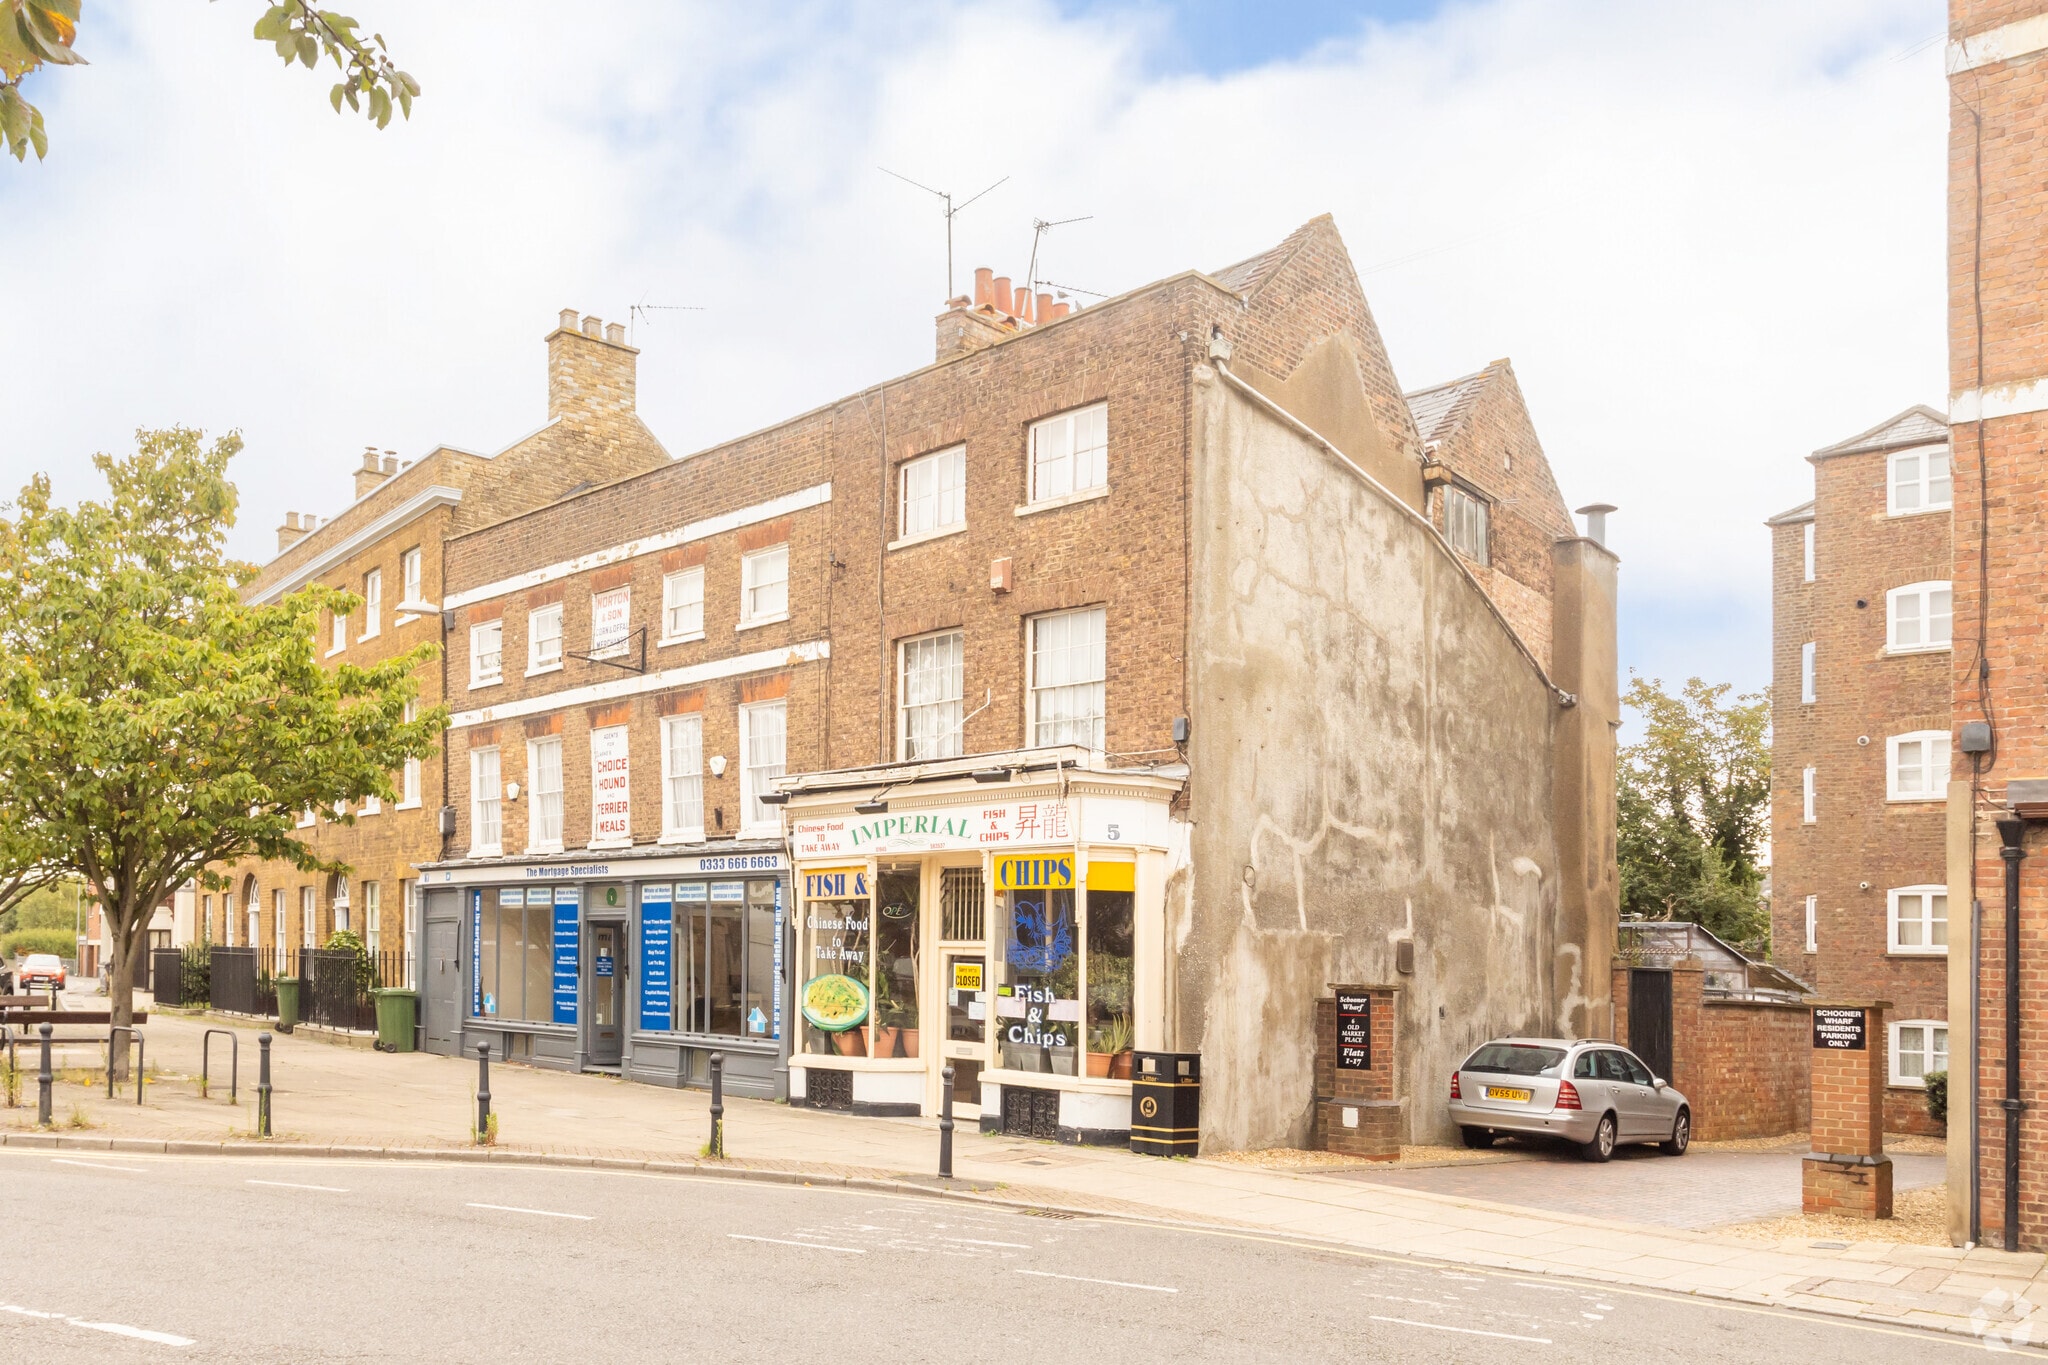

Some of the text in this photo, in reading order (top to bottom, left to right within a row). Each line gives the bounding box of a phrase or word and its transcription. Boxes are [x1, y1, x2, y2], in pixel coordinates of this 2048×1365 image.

[597, 591, 629, 608] NORTON
[608, 608, 622, 620] SON
[598, 758, 627, 773] CHOICE
[599, 776, 625, 790] HOUND
[598, 801, 628, 815] TERRIER
[983, 809, 1006, 820] FISH
[600, 820, 625, 833] MEALS
[798, 822, 843, 833] Chinese Food
[990, 821, 997, 830] &
[1015, 804, 1068, 840] 昇龍
[852, 815, 972, 846] IMPERIAL
[980, 832, 1009, 842] CHIPS
[1107, 824, 1120, 840] 5
[816, 834, 825, 842] TO
[801, 843, 840, 852] TAKE AWAY
[700, 856, 778, 870] 0333 666 6663
[526, 864, 609, 877] The Mortgage Specialists
[1001, 857, 1071, 887] CHIPS
[806, 872, 868, 897] FISH &
[807, 915, 868, 930] Chinese Food
[832, 938, 841, 947] to
[816, 946, 864, 963] Take Away
[956, 975, 980, 986] CLOSED
[1014, 985, 1056, 1003] Fish
[1028, 1007, 1042, 1023] &
[1343, 1004, 1364, 1012] Wharf
[1008, 1026, 1066, 1048] Chips
[1343, 1048, 1364, 1057] Flats
[1345, 1058, 1362, 1066] 1-17
